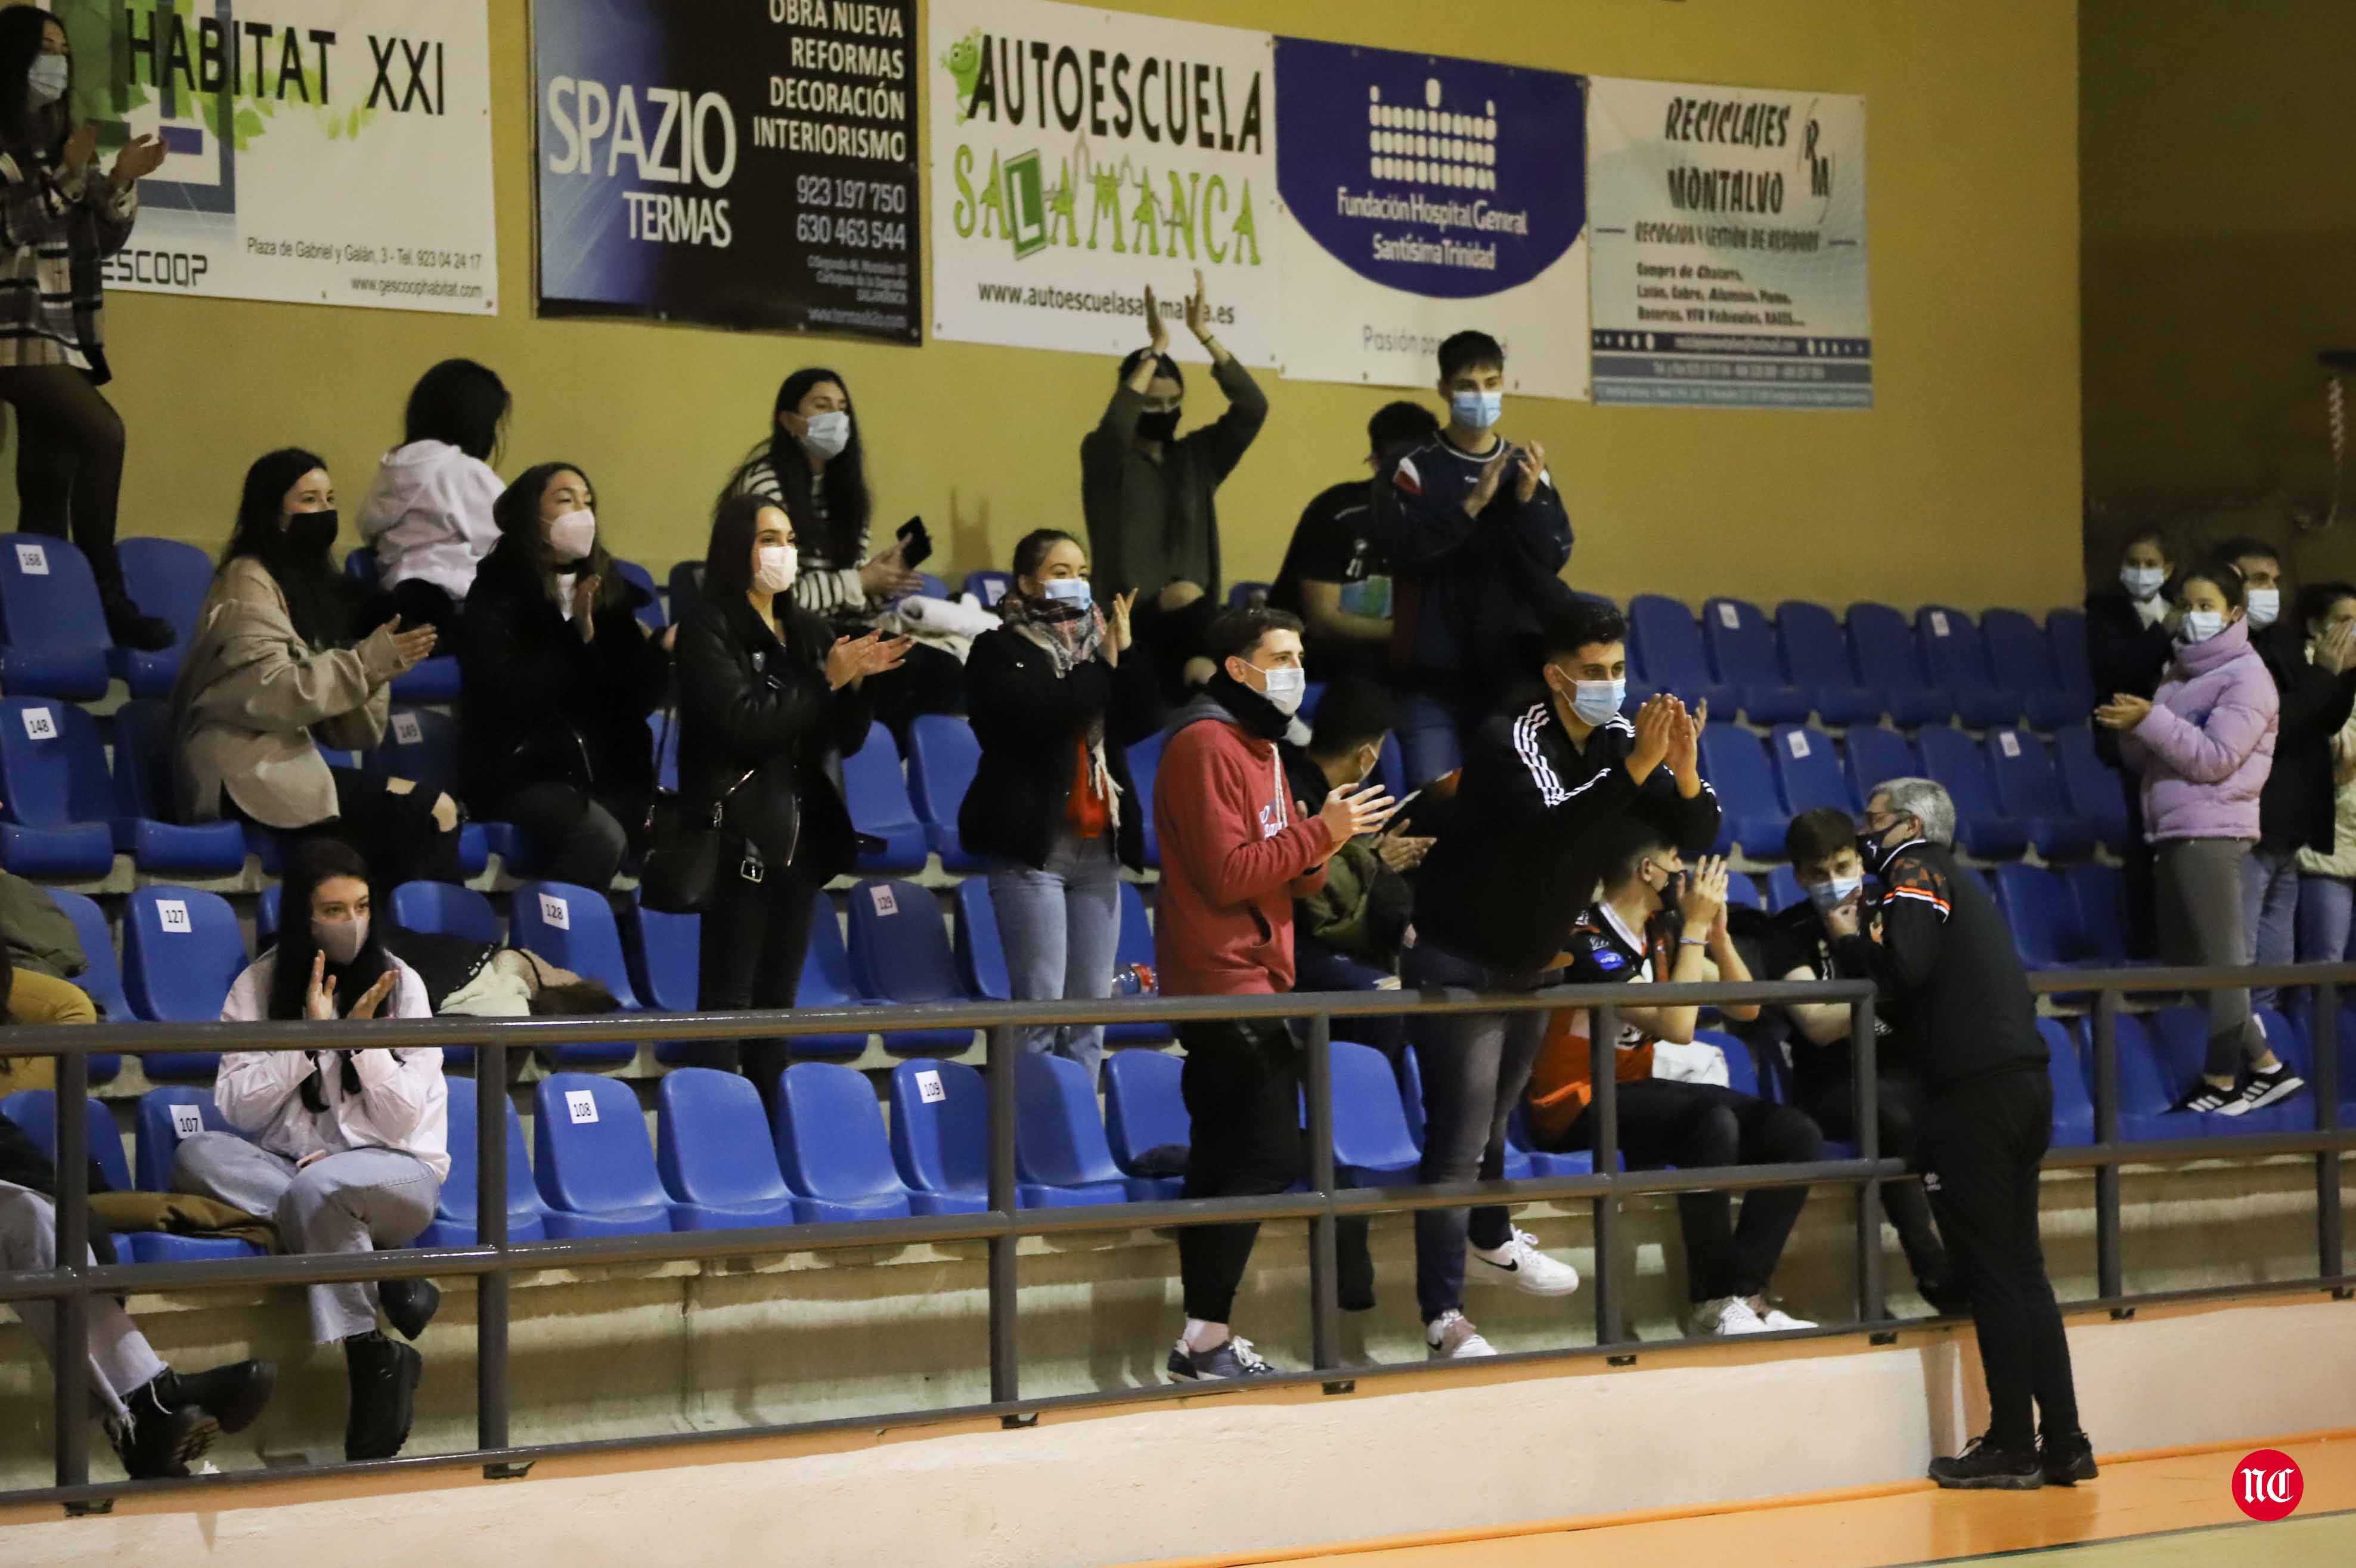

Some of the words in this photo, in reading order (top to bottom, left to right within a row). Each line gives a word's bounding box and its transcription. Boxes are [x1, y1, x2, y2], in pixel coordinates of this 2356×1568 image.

[770, 0, 828, 29] OBRA
[833, 2, 904, 38] NUEVA
[126, 8, 336, 104] HABITAT
[365, 35, 444, 115] XXI
[790, 37, 904, 79] REFORMAS
[770, 76, 905, 120] DECORACIÓN
[966, 34, 1262, 155] AUTOESCUELA
[547, 75, 736, 188] SPAZIO
[754, 116, 906, 162] INTERIORISMO
[1665, 97, 1791, 149] RECICLAJES
[796, 175, 831, 206] 923
[835, 179, 866, 209] 197
[869, 182, 906, 214] 750
[954, 143, 1261, 266] SALAMANCA
[1667, 166, 1784, 214] MONTALVO
[623, 191, 731, 248] TERMAS
[1337, 186, 1410, 221] Fundación
[1410, 193, 1472, 233] Hospital
[1472, 200, 1529, 235] General
[796, 213, 831, 244] 630
[835, 217, 869, 247] 463
[871, 221, 906, 250] 544
[247, 236, 277, 256] Plaza
[280, 239, 292, 256] de
[296, 240, 333, 259] Gabriel
[336, 247, 341, 264] y
[381, 247, 388, 264] 3
[396, 248, 413, 266] Tel.
[417, 249, 435, 268] 923
[438, 252, 451, 268] 04
[454, 253, 467, 269] 24
[470, 254, 482, 269] 17
[1372, 233, 1443, 264] Santísima
[1442, 238, 1496, 270] Trinidad
[351, 277, 483, 298] www.gescoophabitat.com
[978, 282, 1235, 324] www.autoescuelasamaa.es
[1363, 324, 1417, 352] Pasión
[30, 718, 49, 734] 148
[166, 909, 184, 924] 127
[545, 904, 563, 921] 128
[878, 895, 893, 910] 129
[924, 1082, 940, 1097] 109
[179, 1117, 199, 1133] 107
[574, 1102, 592, 1117] 108
